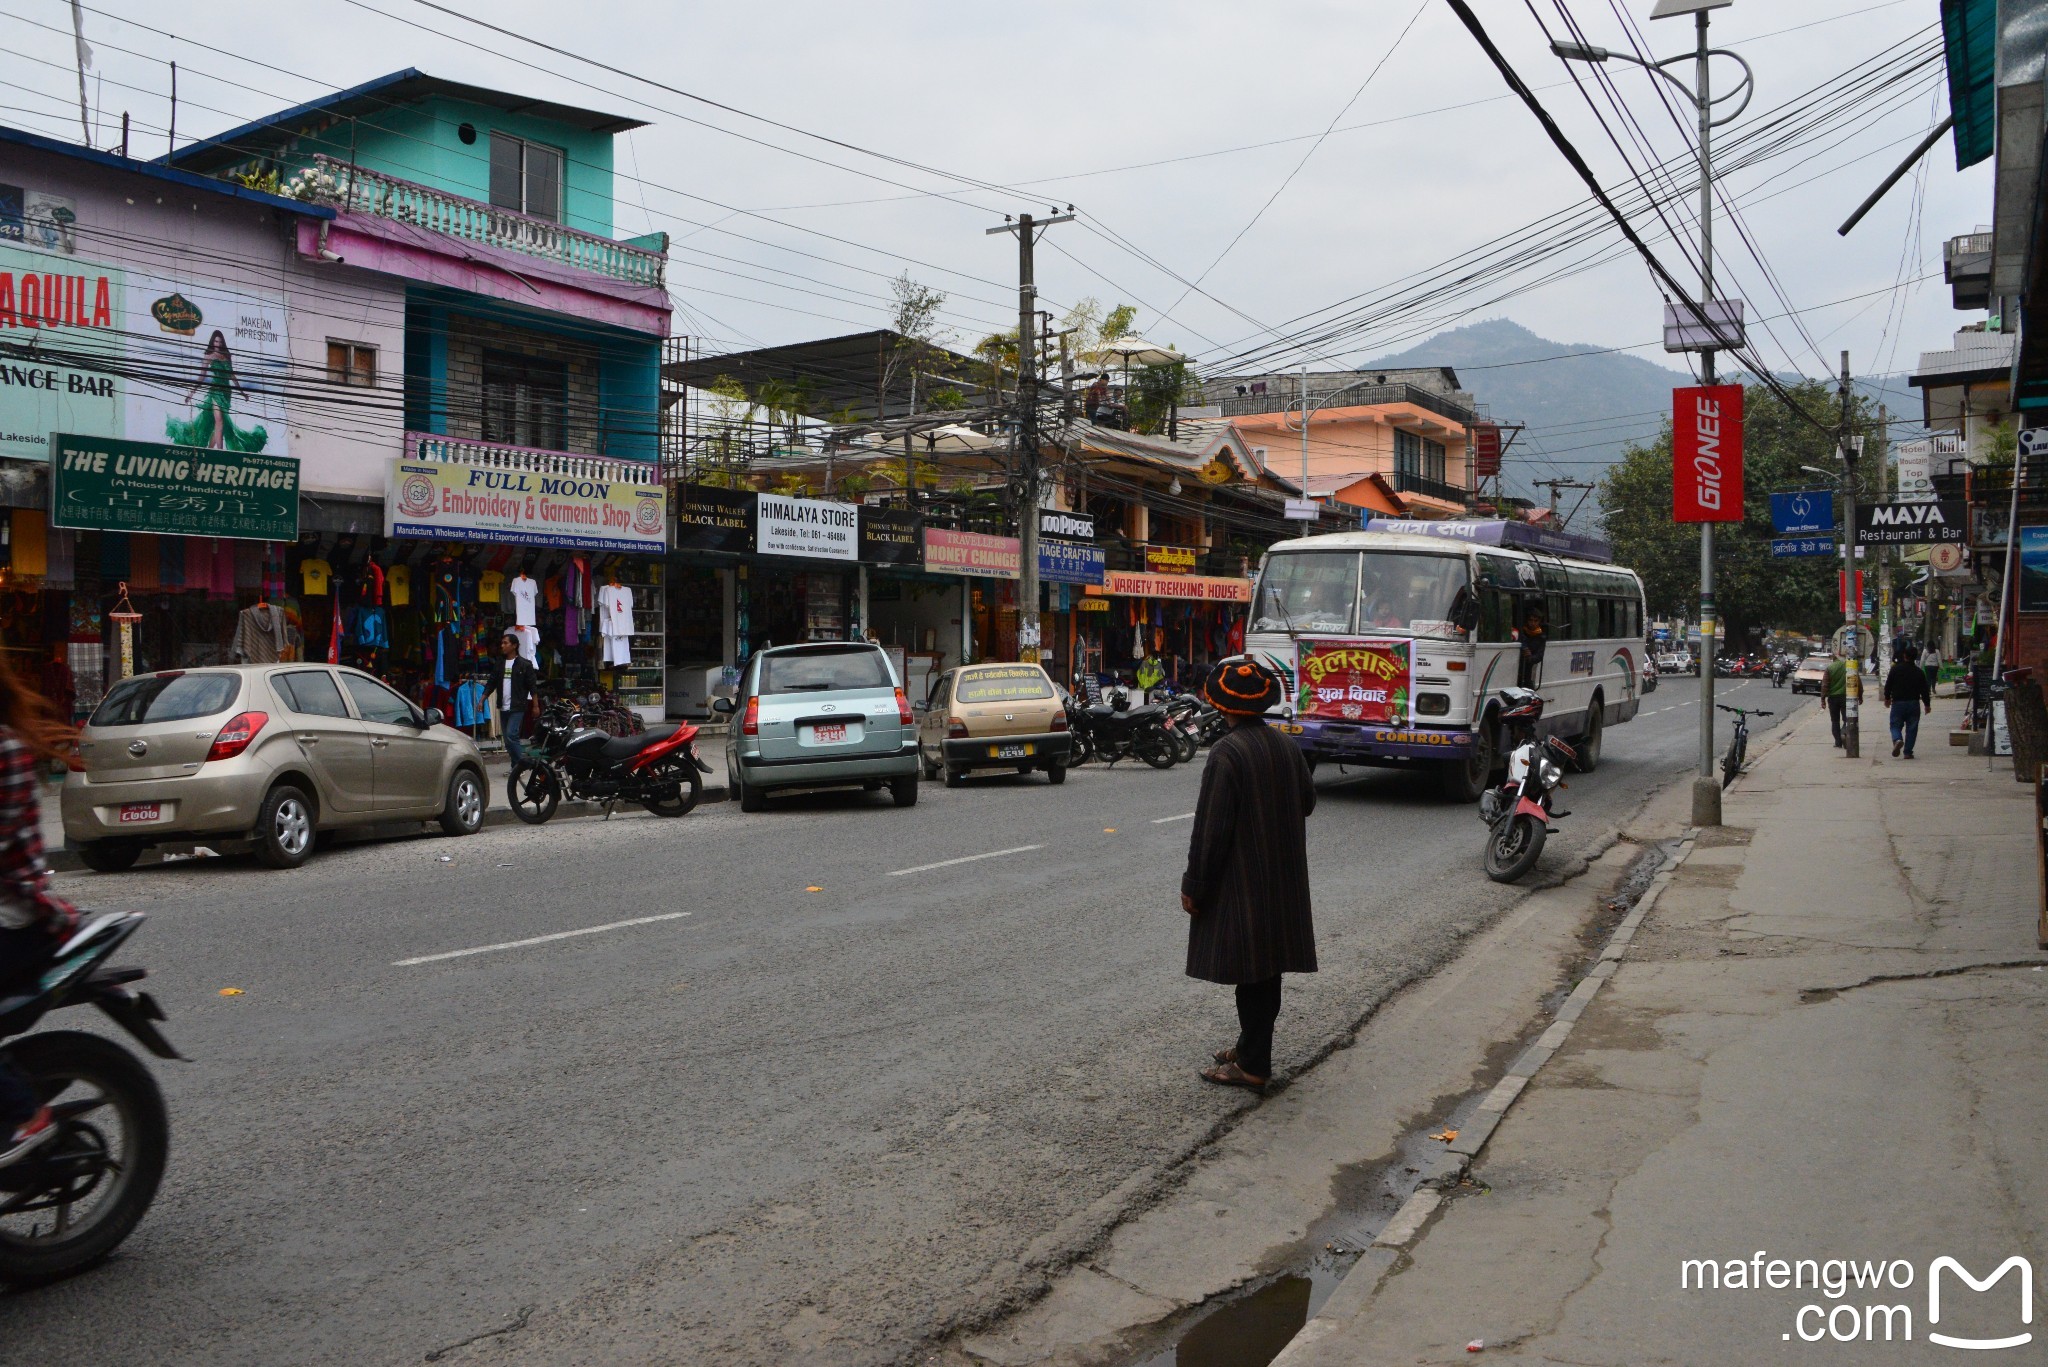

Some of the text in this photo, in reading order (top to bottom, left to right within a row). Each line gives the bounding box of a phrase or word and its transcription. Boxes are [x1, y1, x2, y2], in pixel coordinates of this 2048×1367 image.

[0, 272, 111, 329] AQUILA
[241, 316, 272, 331] MAKE AN
[235, 328, 278, 343] IMPRESSION
[68, 373, 114, 398] BAR
[0, 432, 49, 447] Lakeside,
[1901, 444, 1926, 454] Hotel
[1899, 457, 1928, 465] Mountain
[63, 449, 297, 491] THE LIVING HERITAGE
[1904, 469, 1923, 479] Top
[127, 480, 165, 490] House
[167, 484, 179, 492] of
[182, 485, 254, 499] Handicrafts)
[468, 469, 610, 499] FULL MOON
[442, 487, 520, 524] Embroidery
[525, 495, 535, 520] &
[540, 497, 598, 525] Garments
[602, 503, 631, 532] Shop
[682, 503, 715, 514] OHNNIE
[761, 501, 855, 528] HIMALAYA STORE
[1871, 505, 1945, 526] MAYA
[682, 513, 747, 529] BLACK LABEL
[396, 525, 434, 538] Manufacture,
[435, 528, 468, 539] Wholesaler,
[468, 531, 488, 540] Retailer
[519, 534, 525, 542] of
[534, 535, 549, 544] Kinds
[576, 538, 600, 547] Garments
[604, 541, 618, 549] Other
[771, 525, 798, 539] Lakeside,
[866, 532, 915, 544] BLACK LABEL
[1860, 526, 1962, 541] Restaurant & Bar
[946, 533, 1007, 549] TRAVELLERS
[926, 544, 969, 564] MONEY
[1062, 546, 1091, 562] CRAFTS
[1092, 550, 1105, 564] INN
[960, 566, 980, 574] CENTRAL
[981, 567, 992, 575] BANK
[1114, 577, 1239, 599] VARIETY TREKKING HOUSE
[1317, 684, 1388, 704] शुभ विवाह
[1375, 730, 1452, 745] CONTROL
